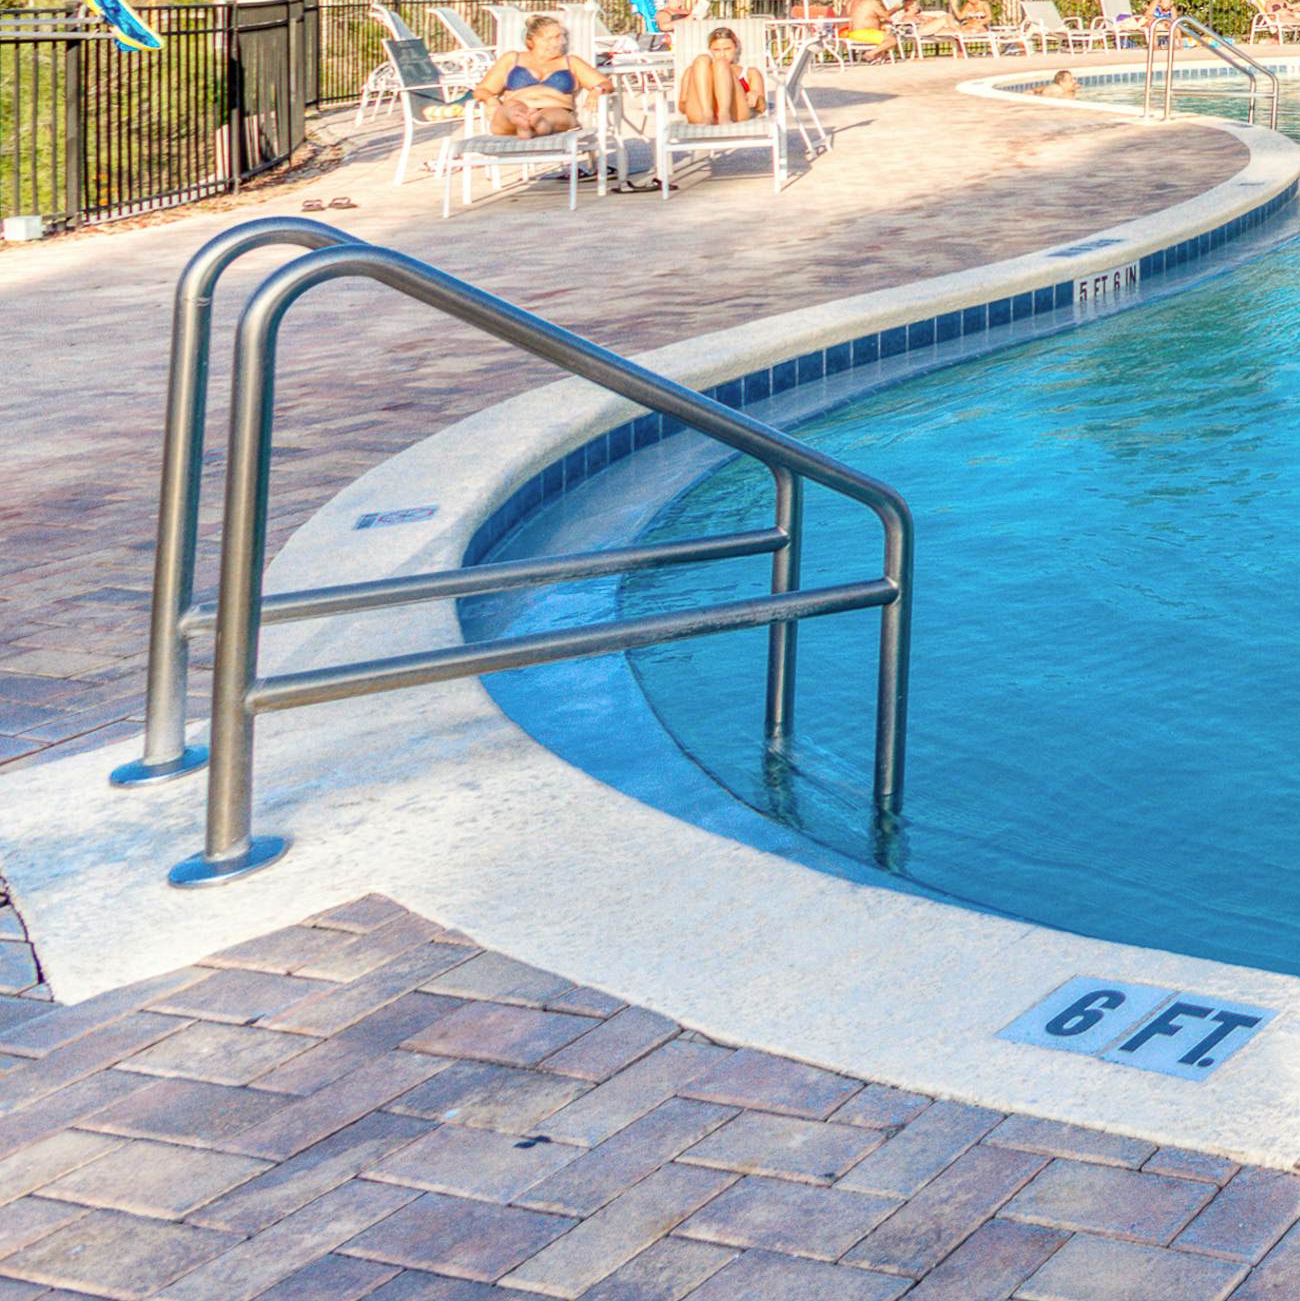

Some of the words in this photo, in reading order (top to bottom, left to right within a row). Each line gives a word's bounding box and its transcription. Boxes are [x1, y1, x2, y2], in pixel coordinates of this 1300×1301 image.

[1079, 281, 1088, 301] 5
[1094, 275, 1108, 297] FT
[1113, 271, 1120, 292] 6
[1125, 264, 1137, 285] IN
[1045, 989, 1127, 1037] 6
[1117, 1002, 1264, 1068] FT.
